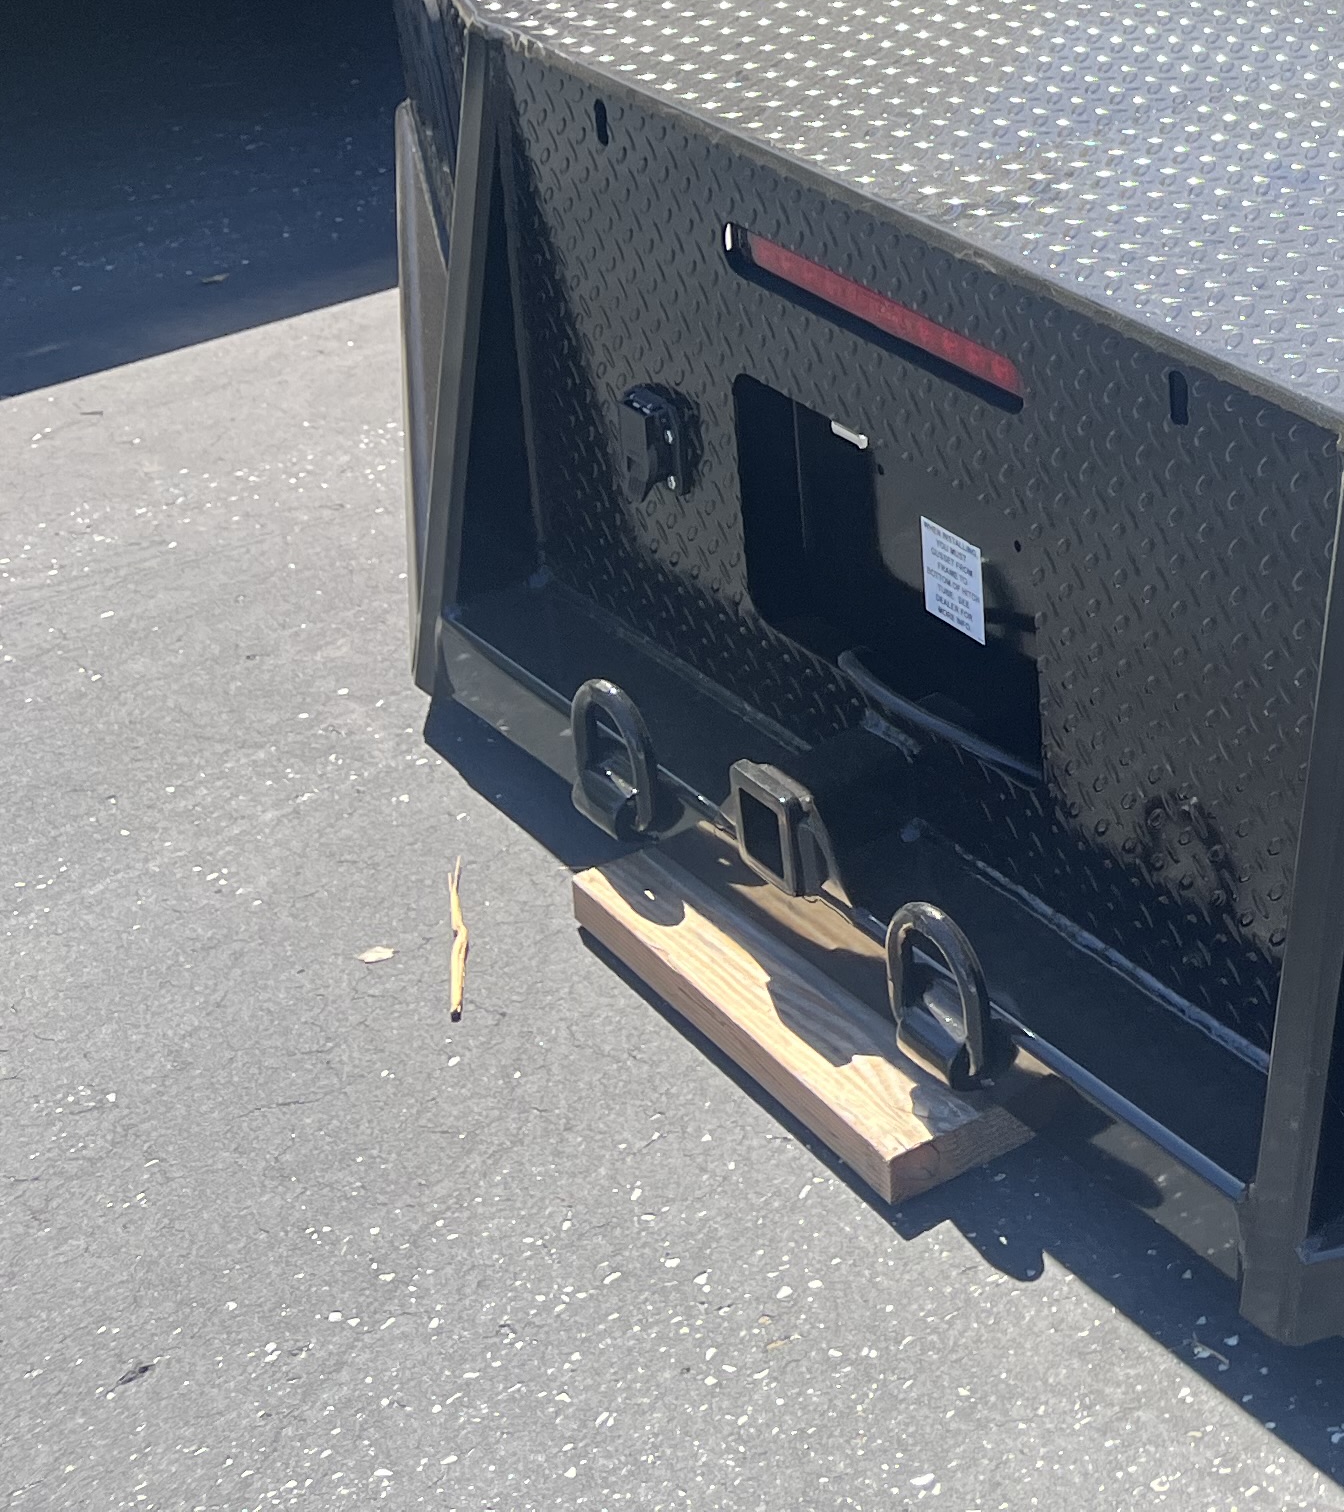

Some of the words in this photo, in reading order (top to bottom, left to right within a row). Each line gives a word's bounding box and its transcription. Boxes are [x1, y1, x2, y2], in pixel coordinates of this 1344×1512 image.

[923, 520, 941, 537] WHEN
[930, 546, 955, 566] GUSSET
[955, 561, 973, 577] FROM
[936, 538, 949, 553] YOU
[950, 547, 967, 563] MUST
[937, 561, 958, 580] FRAME
[926, 566, 951, 587] BOTTOM
[961, 587, 980, 603] HITCH
[935, 593, 959, 613] DEALER
[960, 608, 973, 622] FOR
[958, 595, 970, 609] SEE
[938, 605, 955, 622] MORE
